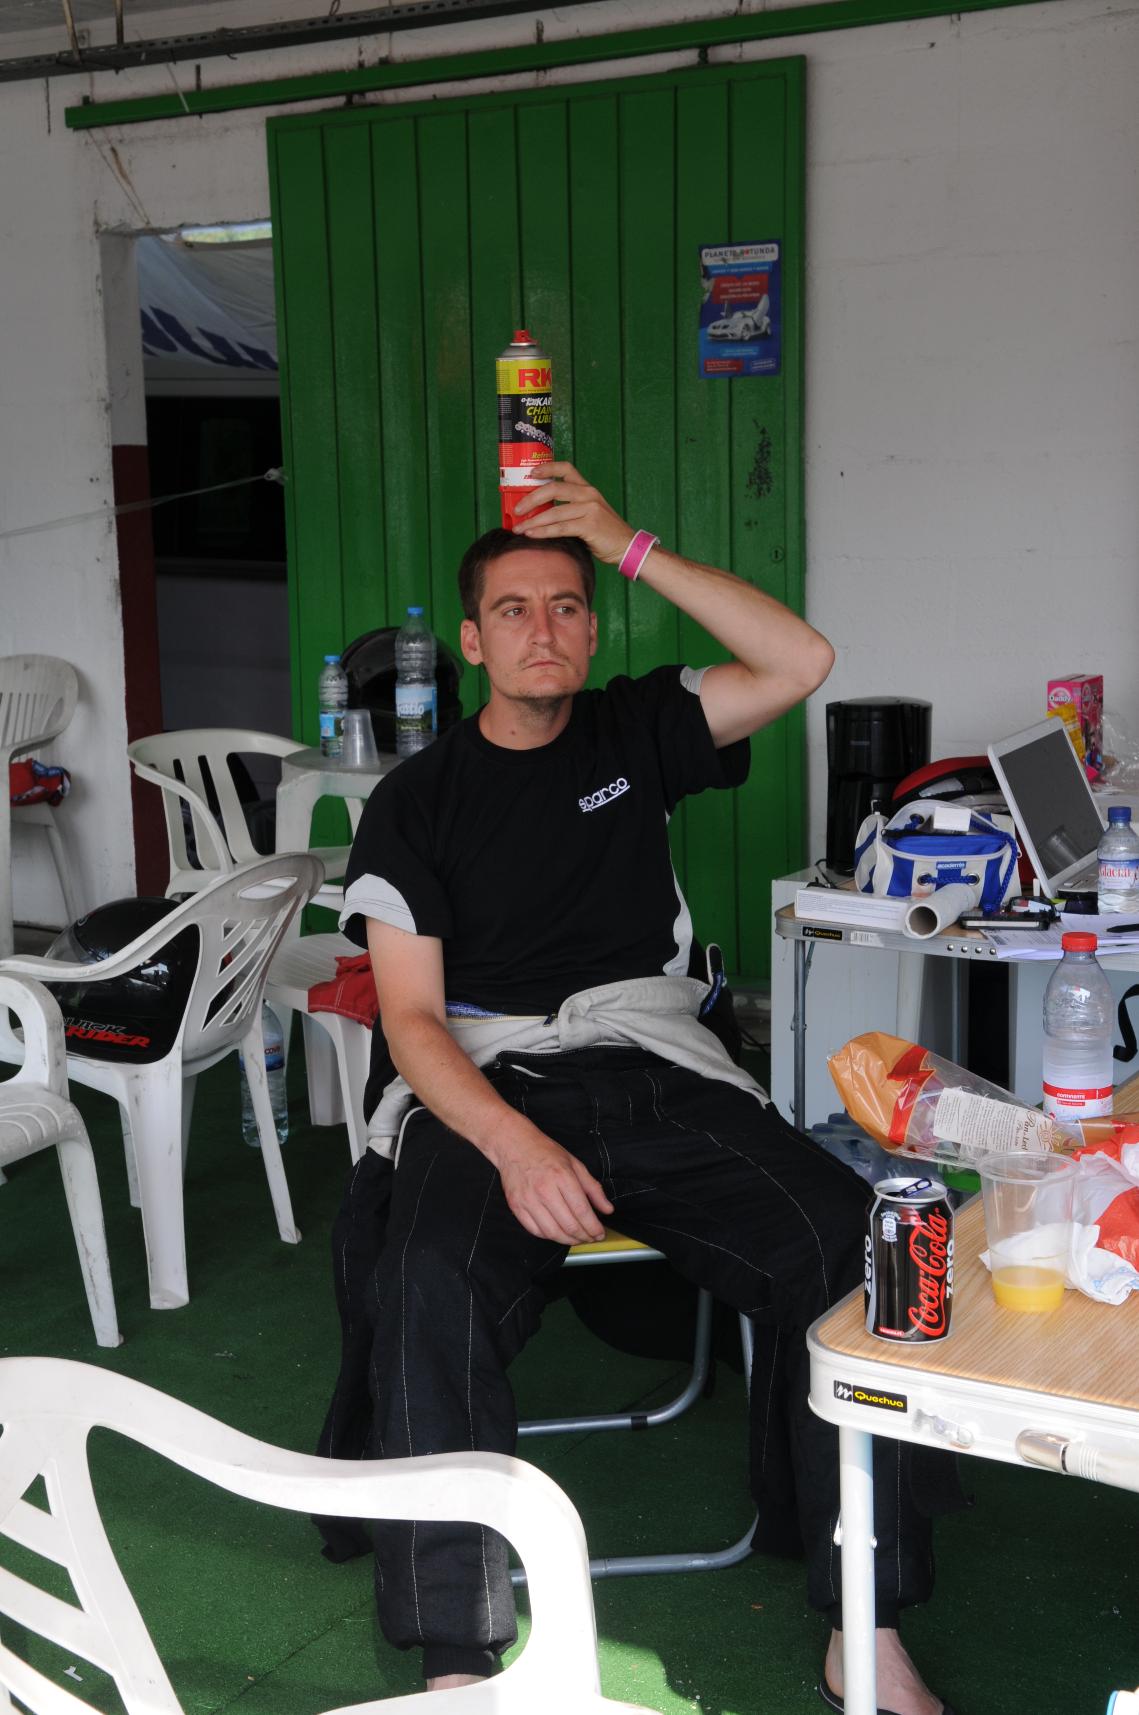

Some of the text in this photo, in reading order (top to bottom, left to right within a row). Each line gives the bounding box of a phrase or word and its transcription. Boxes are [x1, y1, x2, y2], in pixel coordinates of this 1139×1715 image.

[518, 368, 552, 387] RK
[578, 777, 630, 812] sparco
[864, 1234, 873, 1296] zero
[908, 1212, 948, 1337] Coca-Cola
[854, 1391, 904, 1408] Quechua
